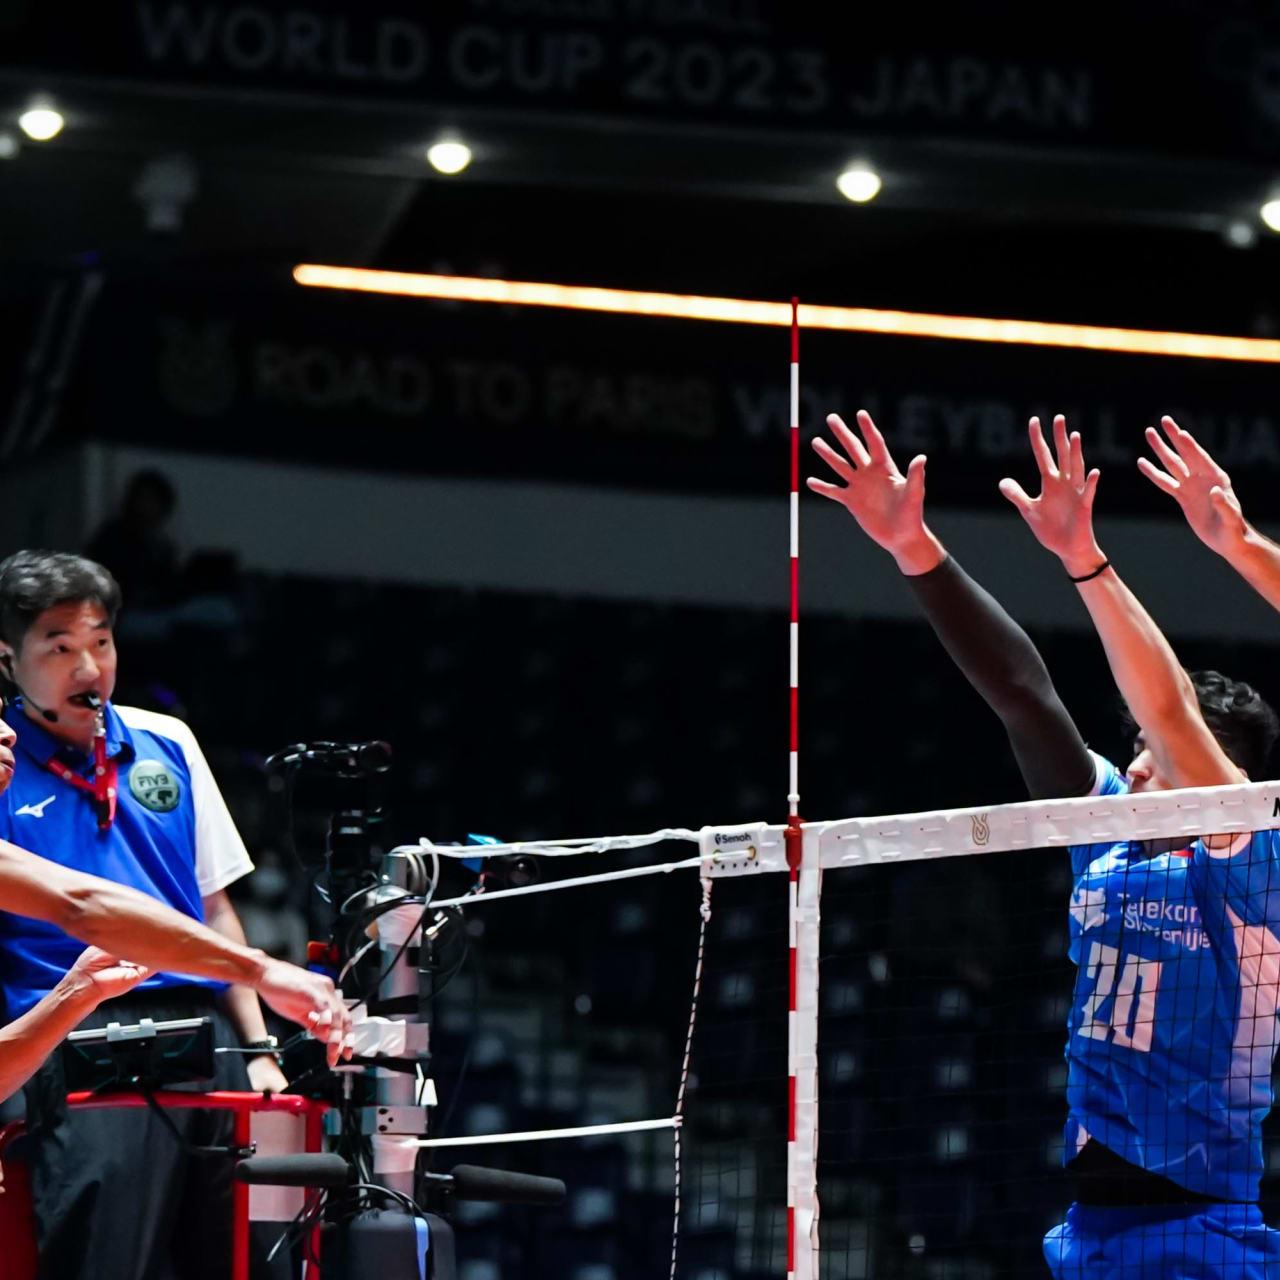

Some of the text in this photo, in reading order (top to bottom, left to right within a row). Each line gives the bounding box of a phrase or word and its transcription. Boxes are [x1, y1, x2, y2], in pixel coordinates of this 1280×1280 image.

[133, 3, 431, 86] WORLD
[446, 22, 605, 93] CUP
[620, 37, 831, 117] 2023
[846, 54, 1096, 130] JAPAN
[722, 833, 752, 843] Senoh
[1077, 941, 1163, 1053] 20
